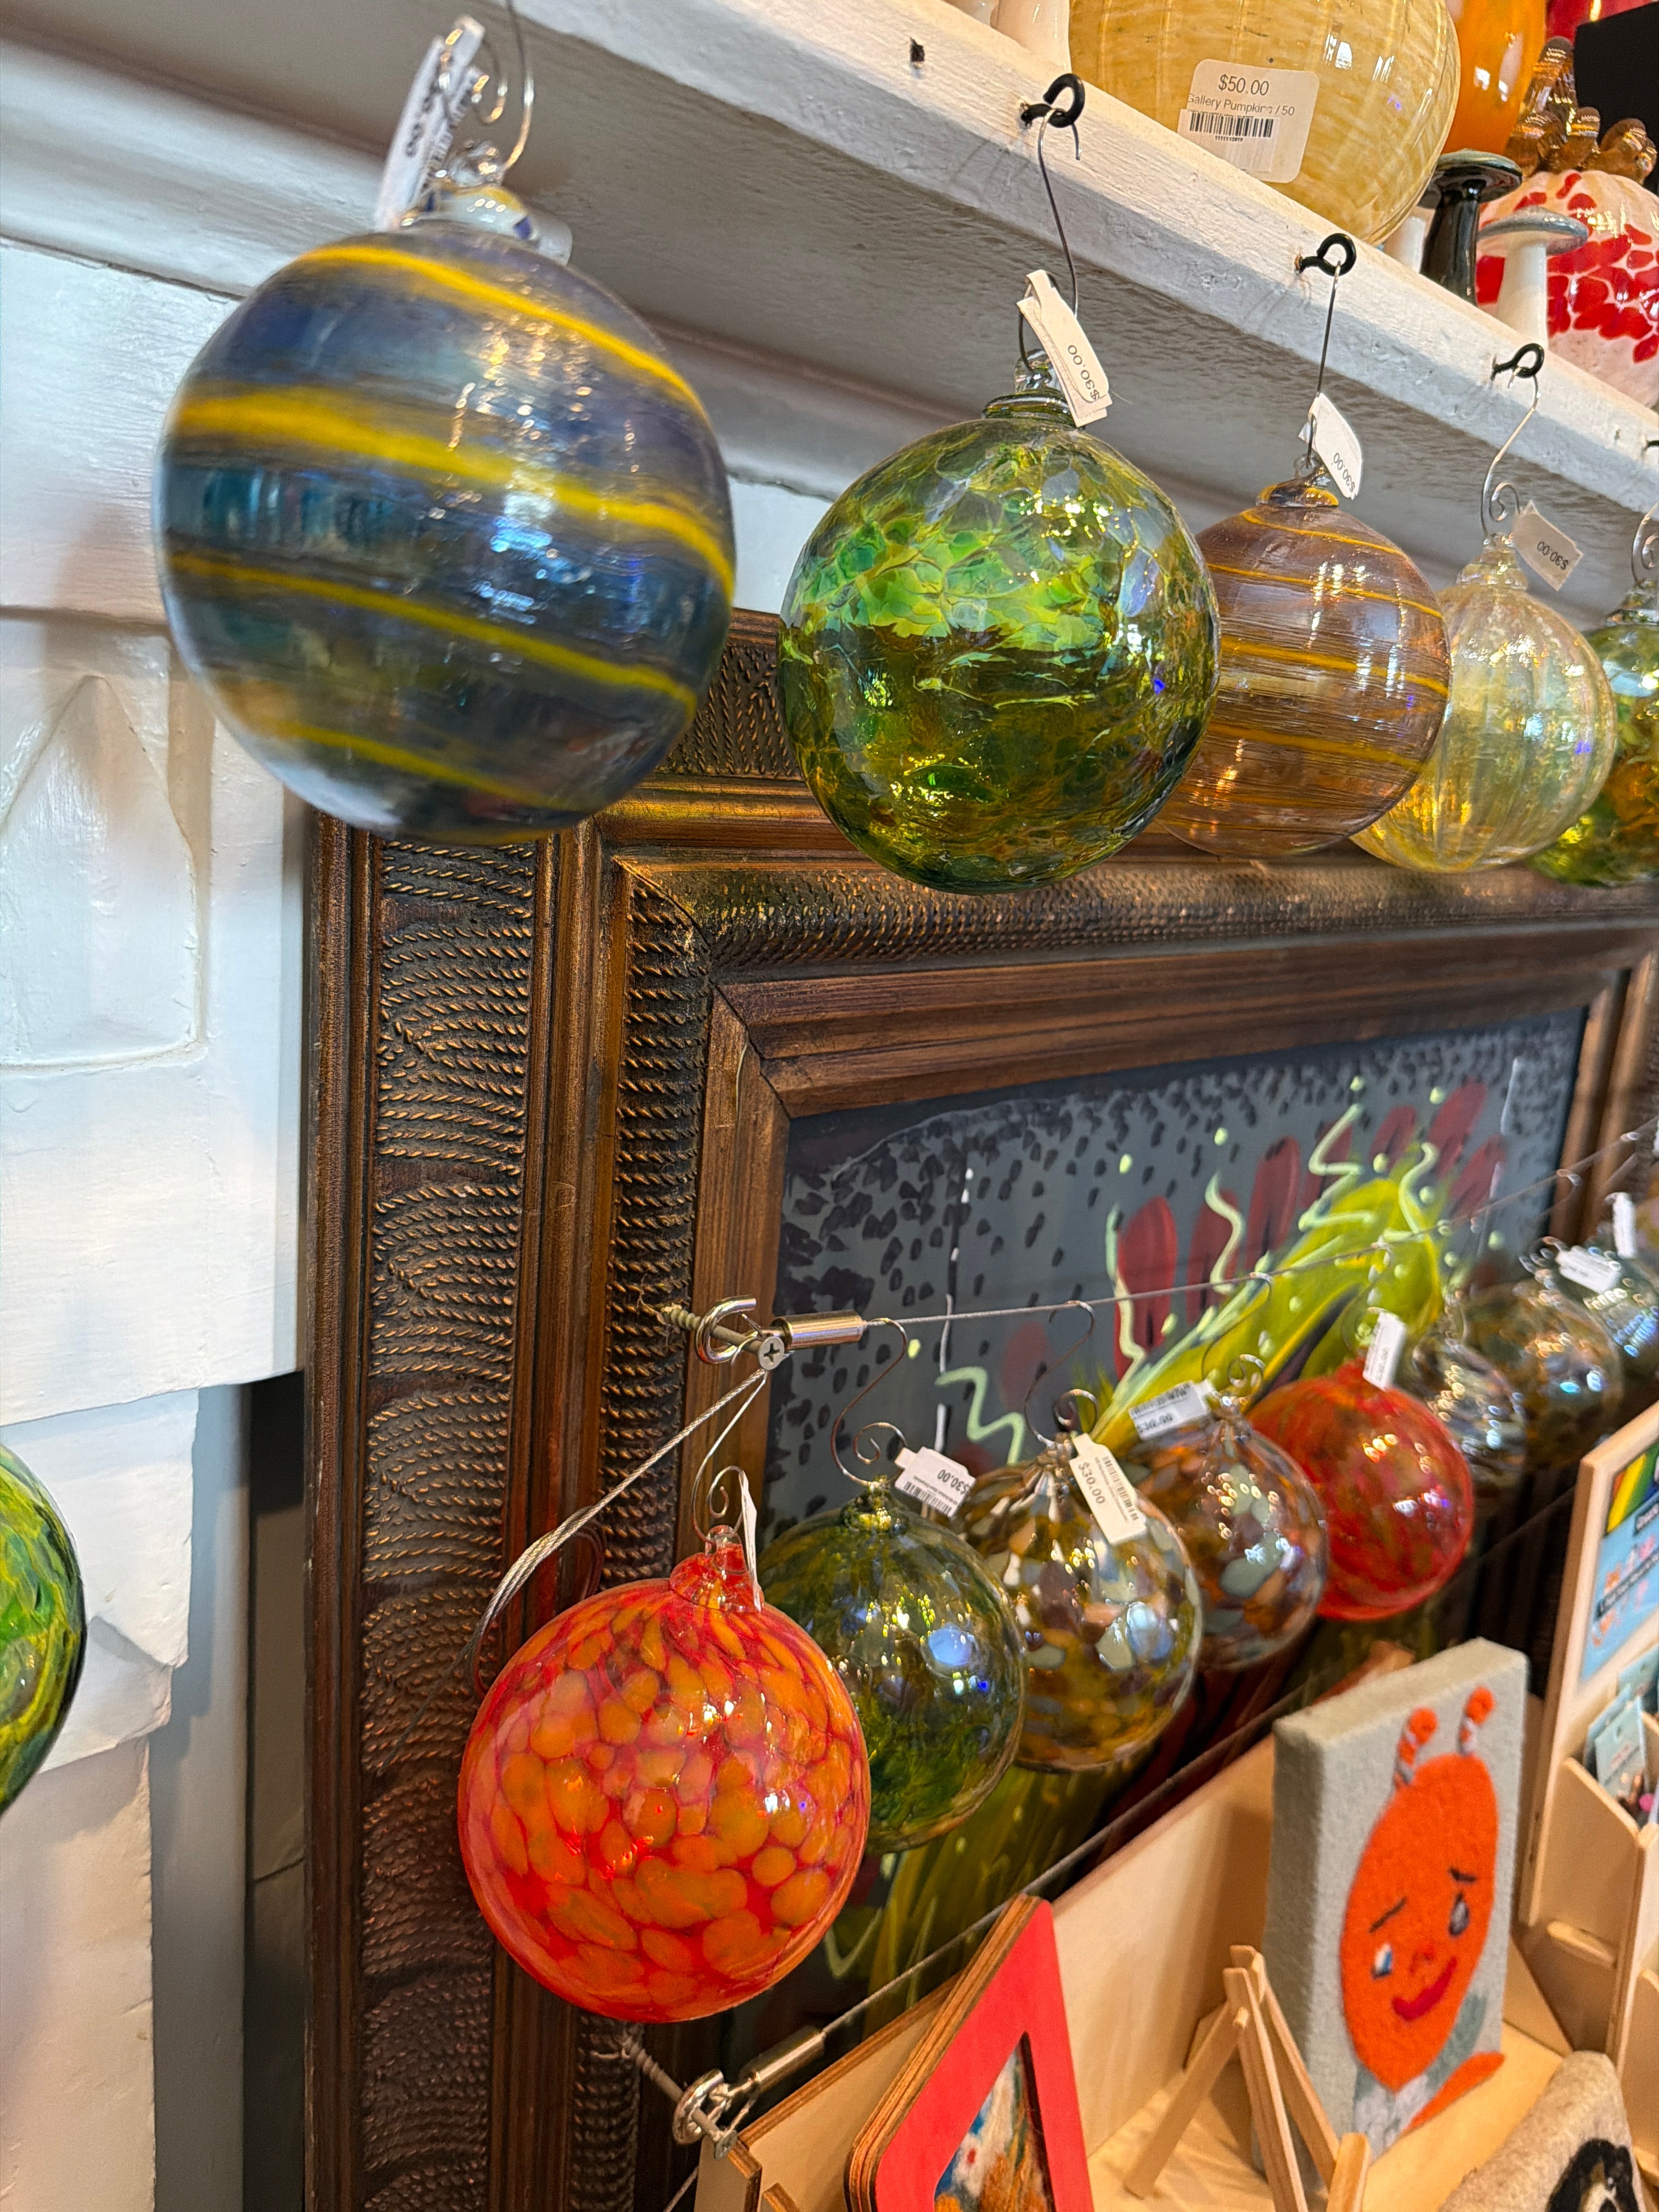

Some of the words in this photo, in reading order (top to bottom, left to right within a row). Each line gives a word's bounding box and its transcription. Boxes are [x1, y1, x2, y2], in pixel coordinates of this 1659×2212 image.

[1218, 73, 1269, 96] $50.00
[1281, 105, 1295, 116] 50
[1067, 344, 1101, 400] $30.00
[1333, 452, 1356, 493] $30.00
[1536, 541, 1569, 571] $30.00
[936, 1469, 970, 1495] $30.00
[1077, 1461, 1106, 1504] $30.00
